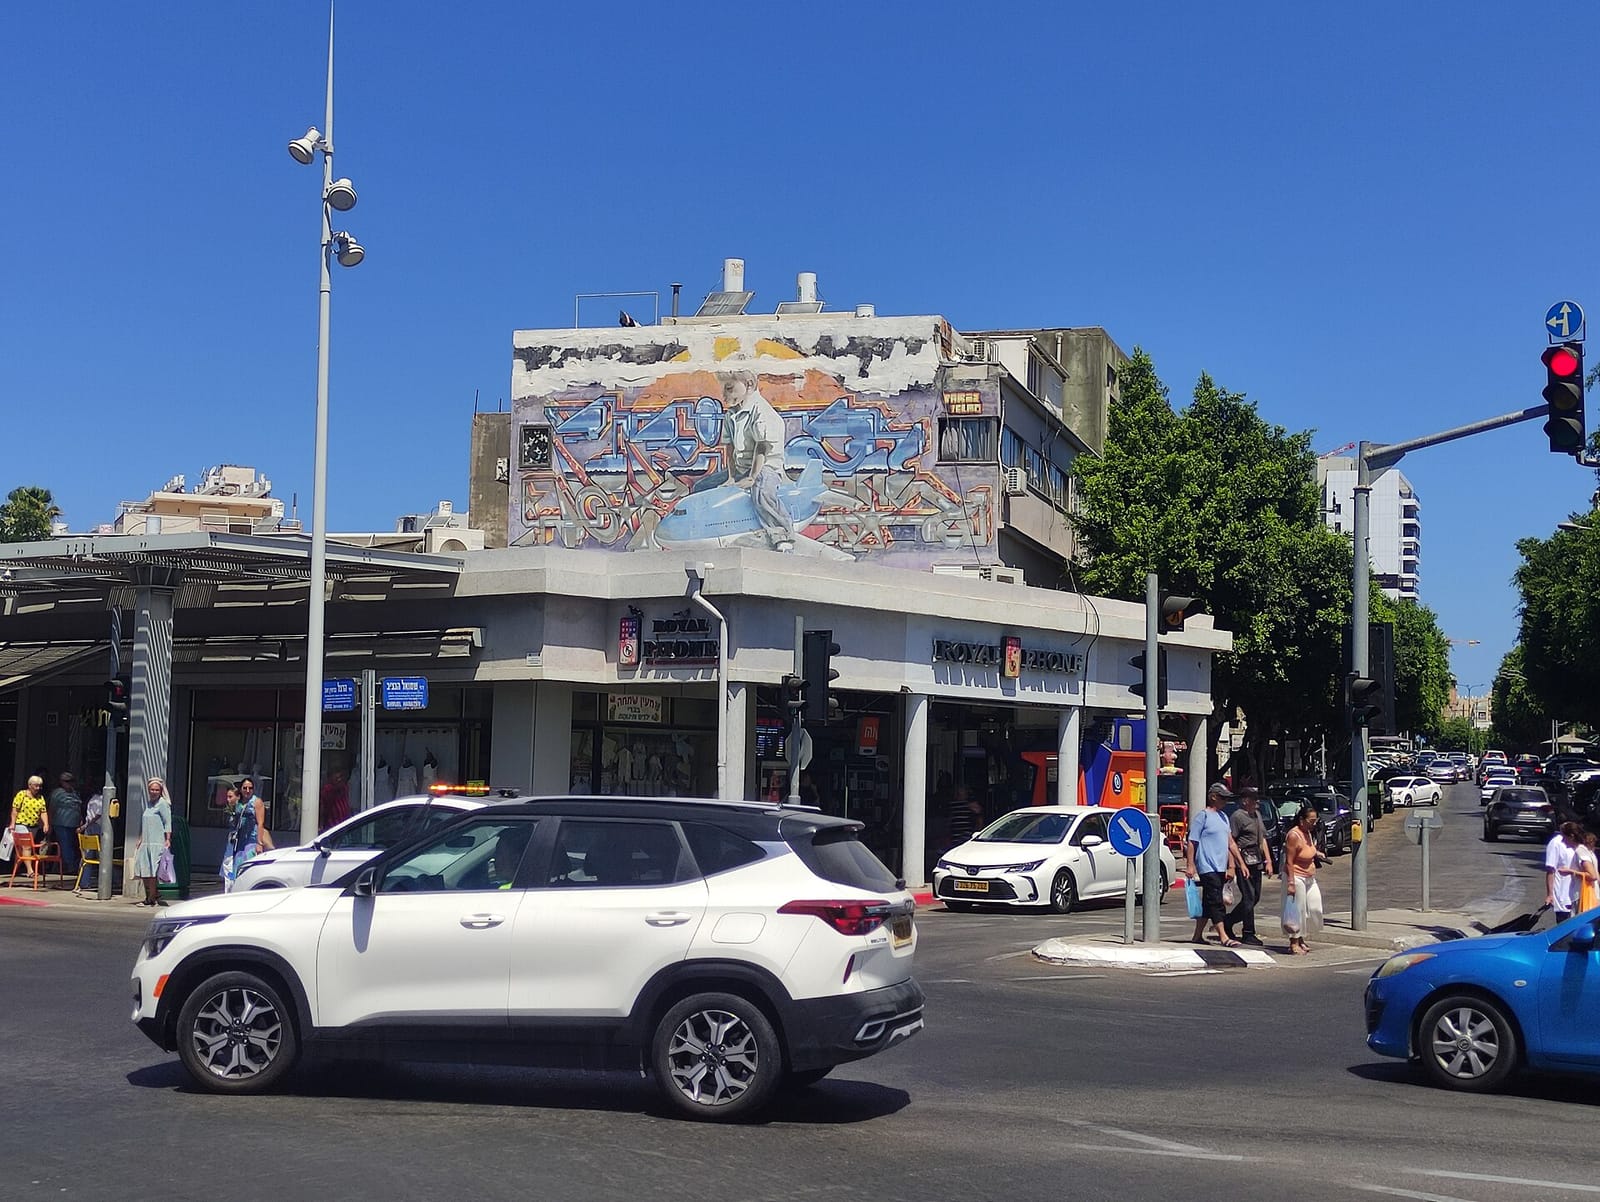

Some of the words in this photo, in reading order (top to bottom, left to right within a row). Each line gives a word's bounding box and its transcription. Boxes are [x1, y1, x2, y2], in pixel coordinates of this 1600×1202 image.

[652, 618, 711, 633] ROYAL
[643, 640, 720, 658] PHONE
[1020, 650, 1083, 672] PHONE
